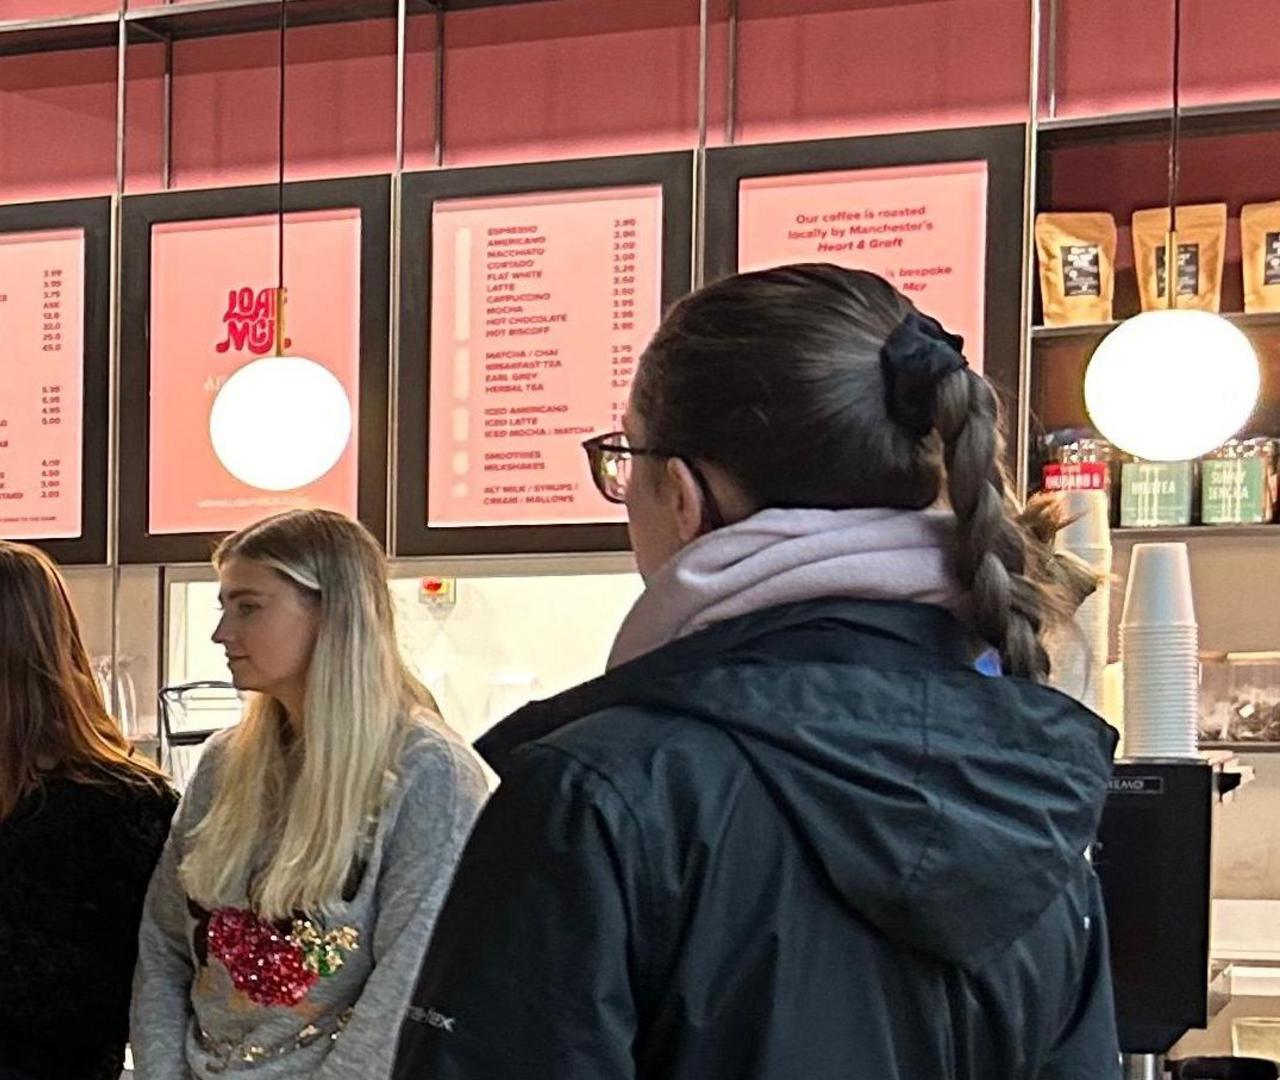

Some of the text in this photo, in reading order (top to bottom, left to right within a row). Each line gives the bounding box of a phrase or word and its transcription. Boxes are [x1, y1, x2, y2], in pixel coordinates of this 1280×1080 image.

[796, 205, 926, 225] Our coffee is roasted
[788, 220, 934, 240] locally by Manchester's
[487, 236, 546, 246] AMERICANO
[817, 237, 904, 252] Heart & Graft
[487, 248, 545, 258] MACCHIATO
[487, 260, 535, 269] CORTADO
[487, 272, 509, 281] FLAT
[512, 270, 543, 279] WHITE
[898, 265, 953, 278] bespoke
[487, 283, 515, 292] LATTE
[486, 306, 524, 314] MOCHA
[486, 317, 505, 326] HOT
[508, 314, 568, 324] CHOCOLATE
[486, 329, 505, 338] HOT
[486, 351, 526, 359] MATCHA
[486, 360, 541, 370] BREAKFAST
[543, 360, 562, 368] TEA
[485, 374, 508, 382] EARL
[511, 372, 538, 381] GREY
[485, 385, 523, 393] HERBAL
[485, 405, 568, 415] ICED AMERICANO
[485, 417, 538, 427] ICED LATTE
[485, 430, 507, 438] ICED
[509, 428, 546, 437] MOCHA
[553, 426, 595, 435] MATCHA
[485, 451, 541, 460] SMOOTHIES
[484, 463, 545, 472] MILKSHAKES
[503, 485, 525, 493] MILK
[533, 484, 573, 492] SYRUPS
[525, 495, 574, 503] MALLOWS
